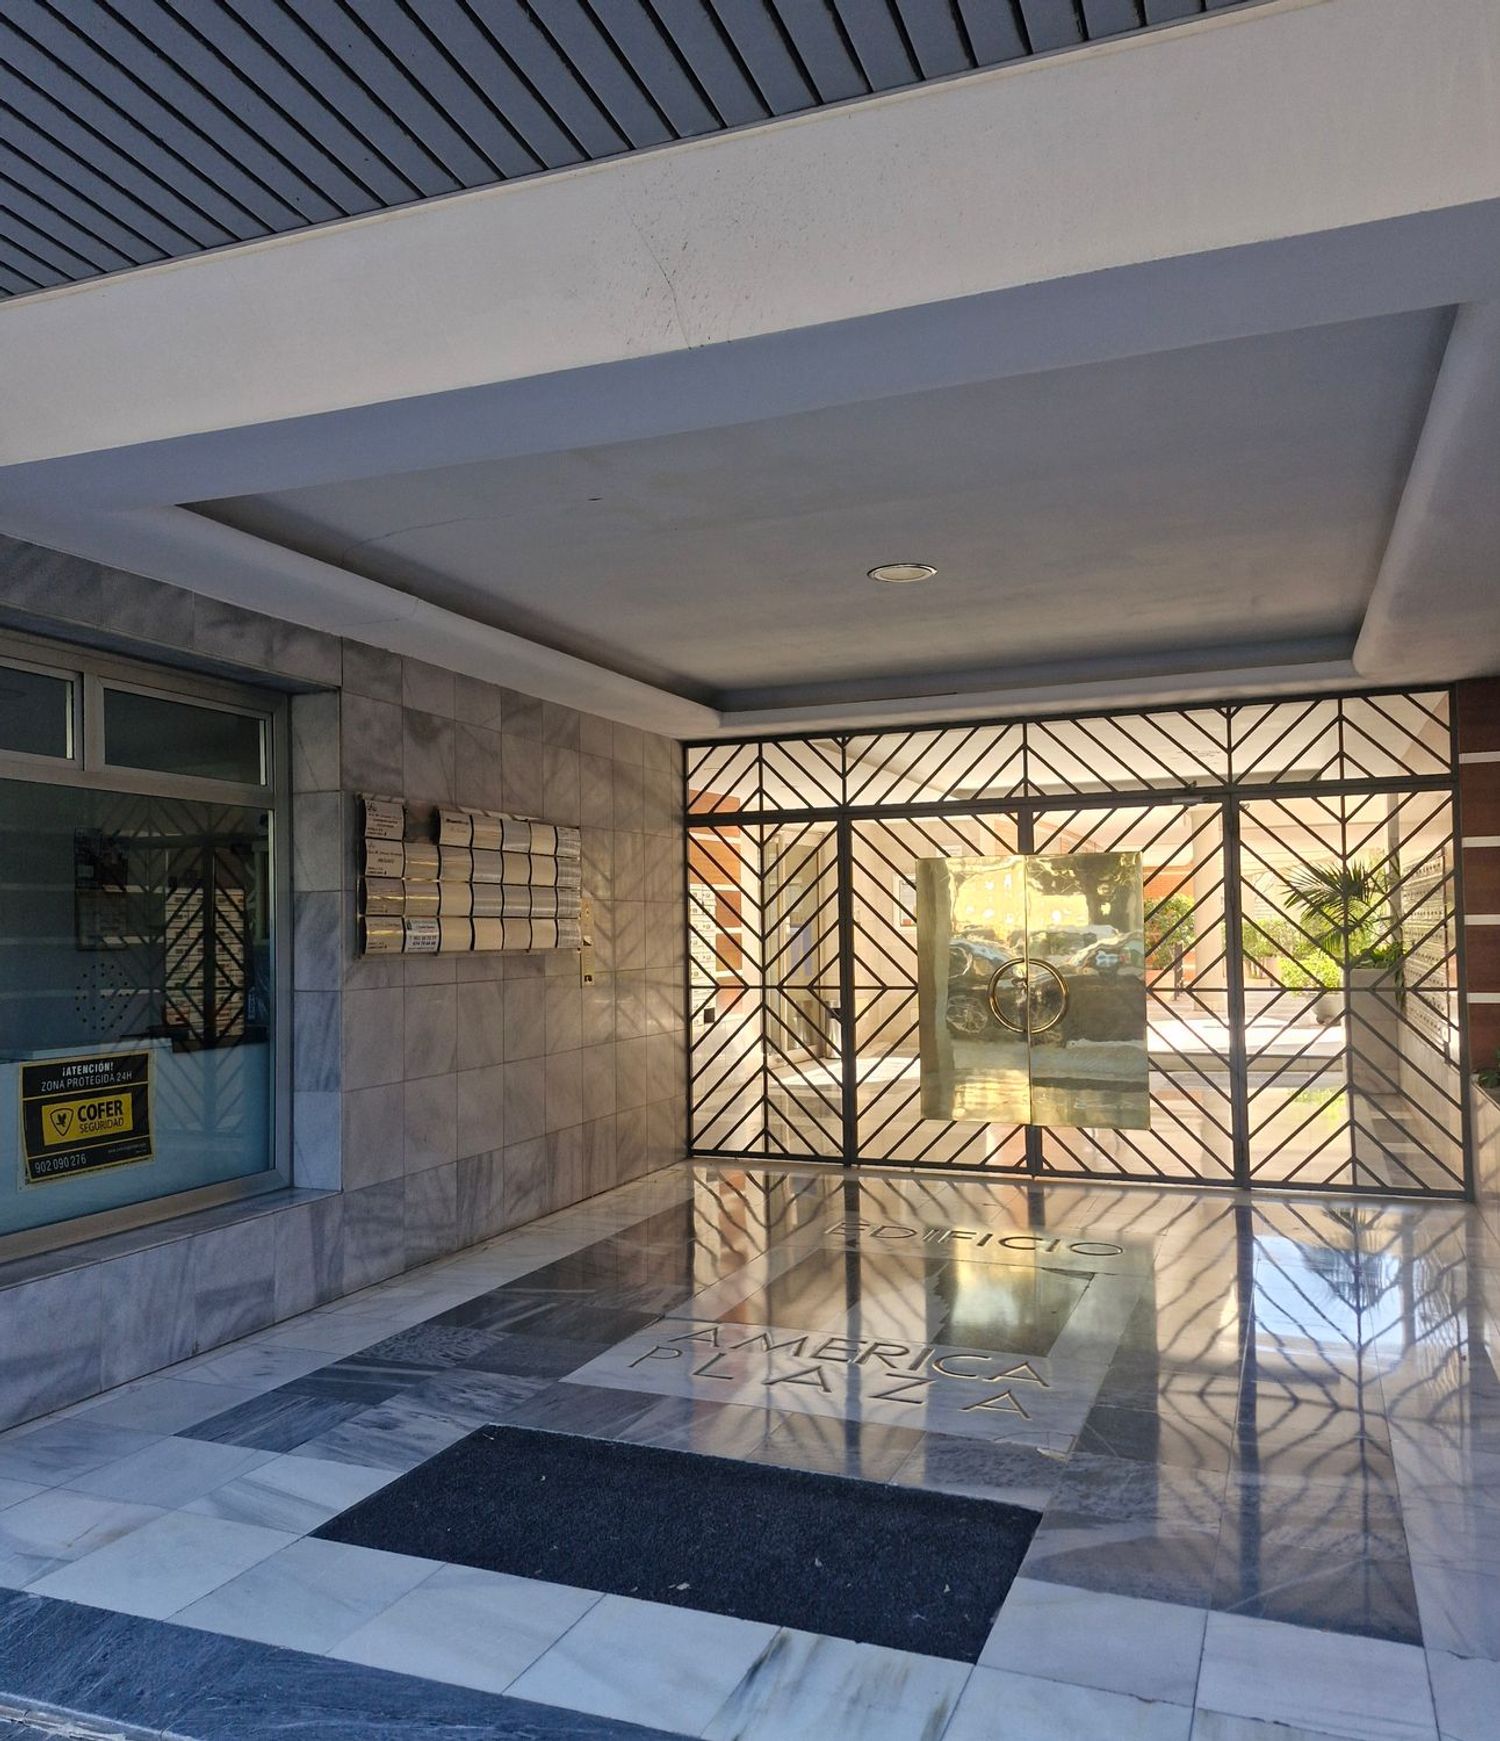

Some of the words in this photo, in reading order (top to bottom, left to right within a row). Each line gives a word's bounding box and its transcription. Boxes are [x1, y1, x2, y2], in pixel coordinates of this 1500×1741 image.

[41, 1080, 65, 1092] ZONA
[66, 1074, 115, 1088] PROTEGIDA
[116, 1071, 133, 1082] 24H
[77, 1100, 123, 1122] COFER
[79, 1117, 124, 1134] SEGURIDAD
[34, 1160, 52, 1174] 902
[53, 1157, 70, 1171] 090
[71, 1153, 87, 1167] 276
[825, 1221, 1124, 1257] EDIFICIO
[668, 1326, 1051, 1389] AMERICA
[627, 1345, 1032, 1421] PLAZA
